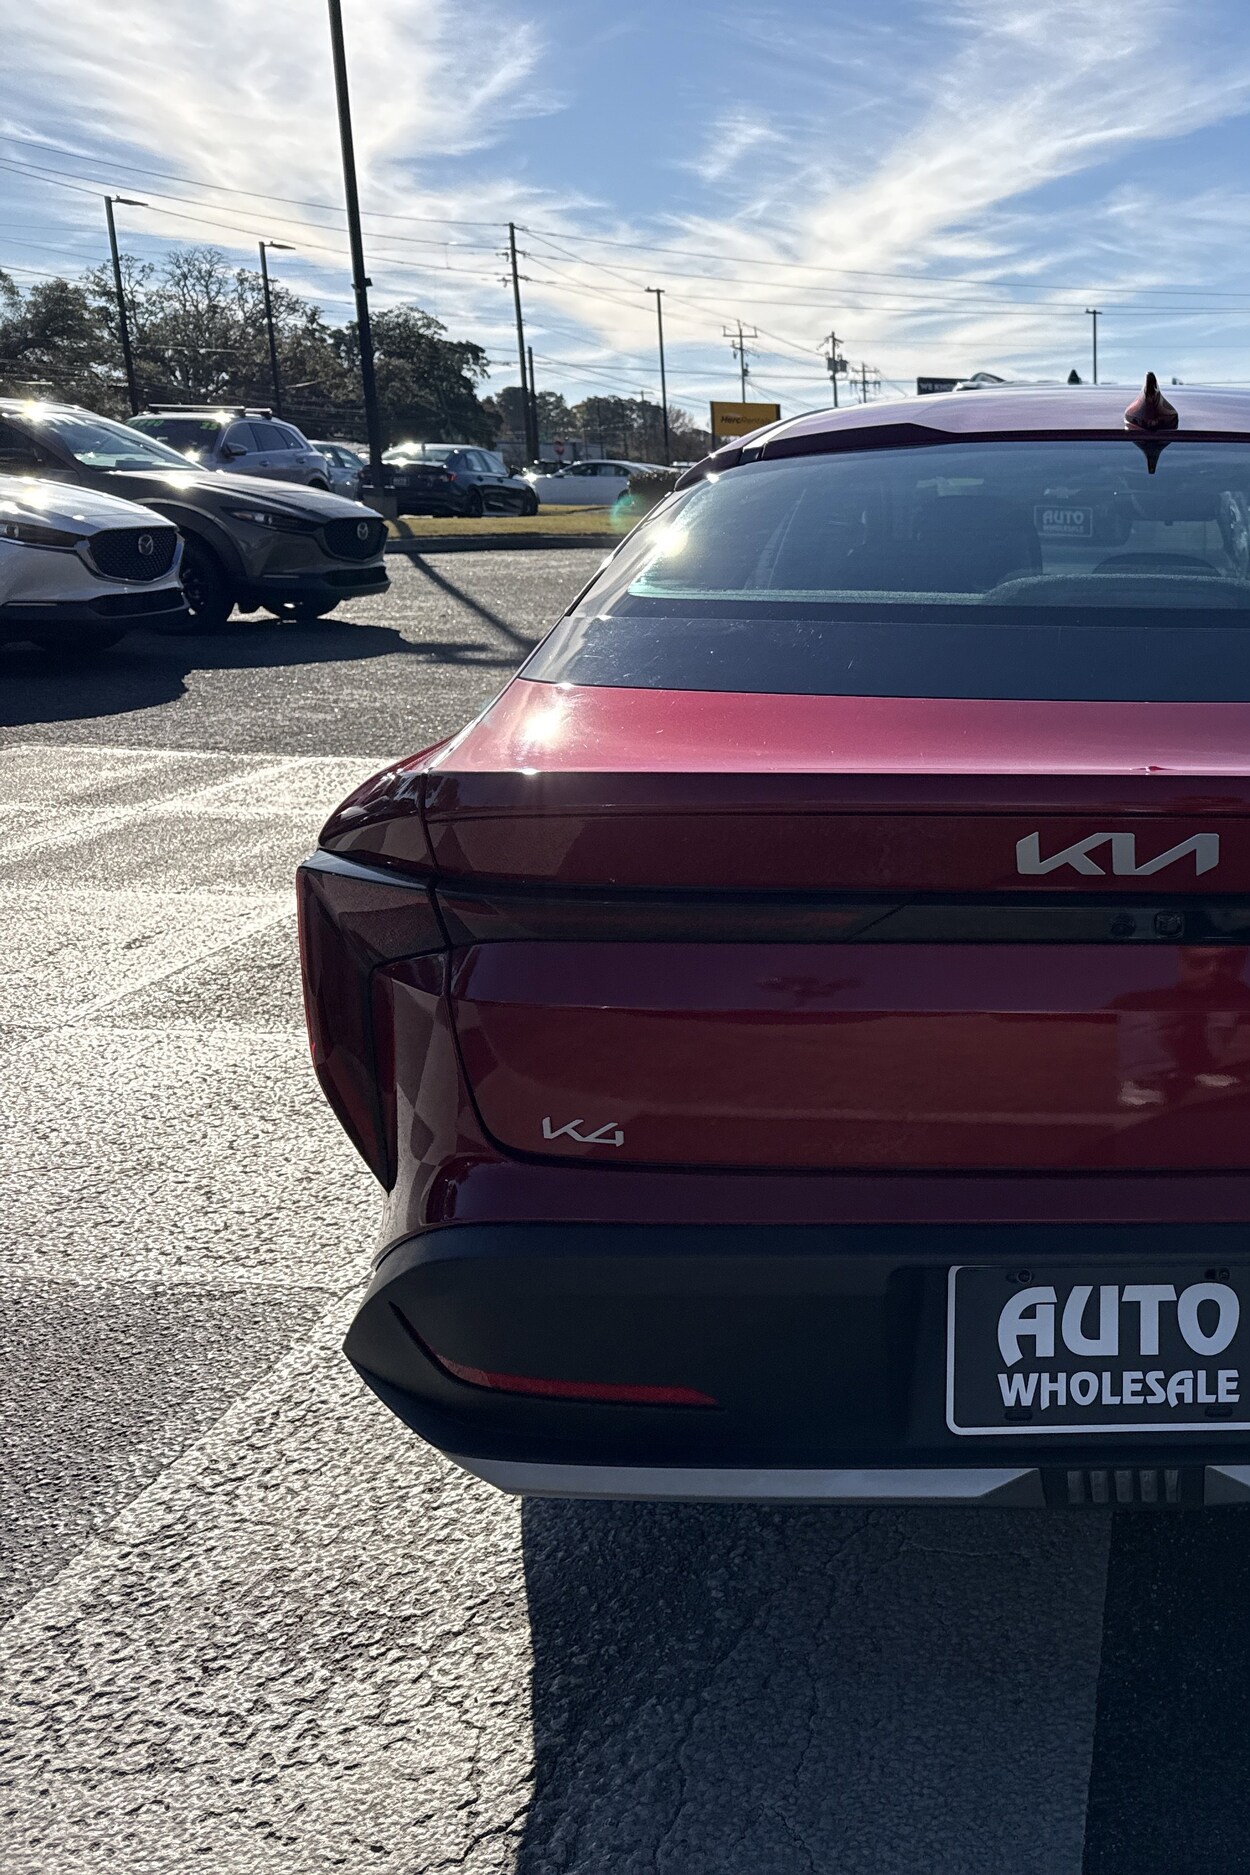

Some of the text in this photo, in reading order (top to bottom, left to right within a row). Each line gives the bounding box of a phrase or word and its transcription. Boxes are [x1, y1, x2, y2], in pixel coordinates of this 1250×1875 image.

[1042, 510, 1084, 525] AUTO
[1016, 831, 1220, 876] KIA
[542, 1116, 624, 1147] K4
[997, 1282, 1240, 1367] AUTO
[997, 1369, 1241, 1411] WHOLESALE
